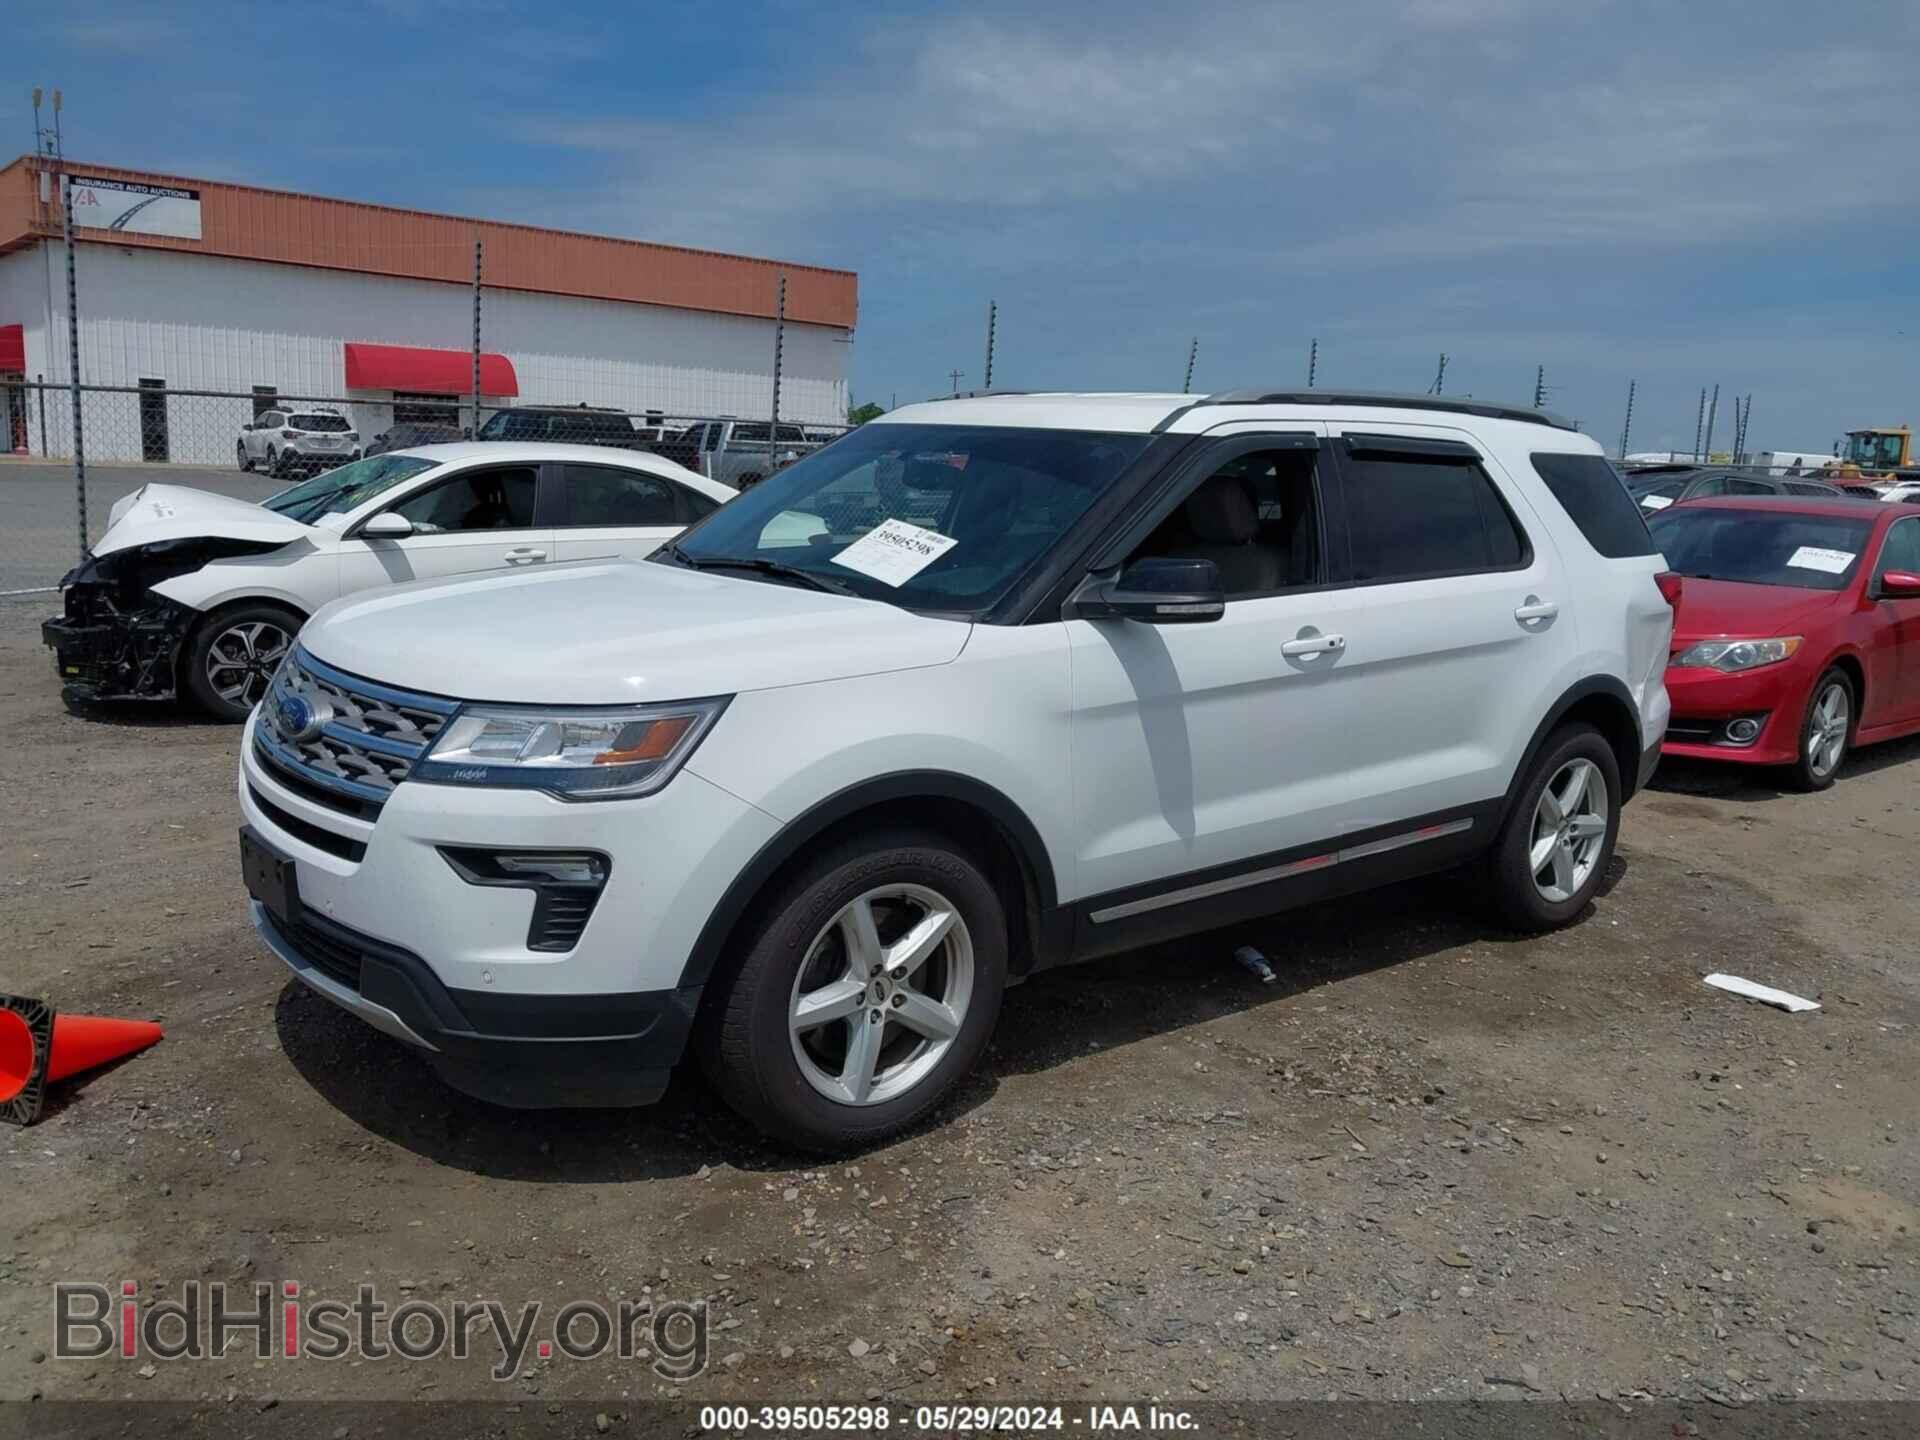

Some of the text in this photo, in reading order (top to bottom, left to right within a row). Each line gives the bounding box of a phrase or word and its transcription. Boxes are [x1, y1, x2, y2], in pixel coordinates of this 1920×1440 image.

[75, 178, 191, 199] INSURANCE AUTO AUCTIONS
